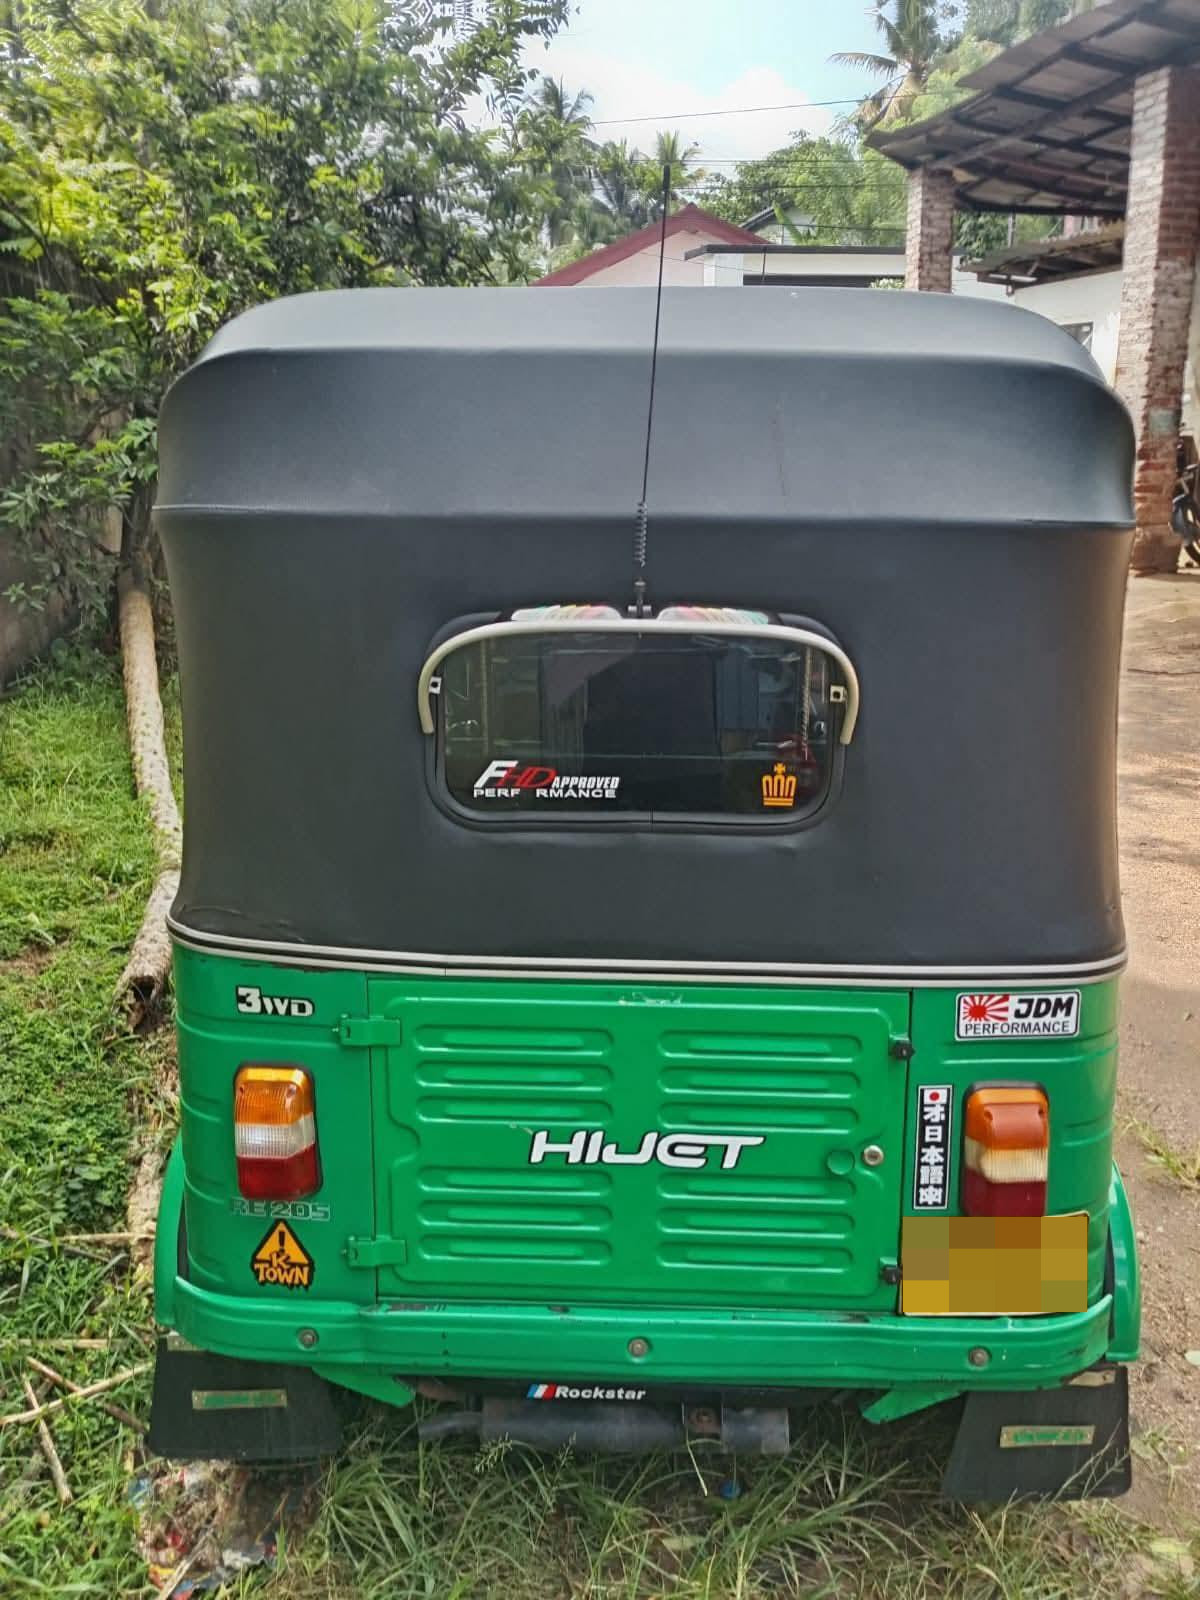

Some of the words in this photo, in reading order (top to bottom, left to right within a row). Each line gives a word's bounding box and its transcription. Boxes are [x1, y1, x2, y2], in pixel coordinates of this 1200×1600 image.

[551, 776, 620, 789] APPROVED
[237, 987, 314, 1017] 3WD
[1014, 996, 1075, 1019] JDM
[965, 1020, 1070, 1036] PERFORMANCE
[529, 1129, 765, 1170] HIJET
[270, 1251, 291, 1269] K
[253, 1262, 311, 1286] TOWN
[555, 1385, 646, 1400] Rockstar
